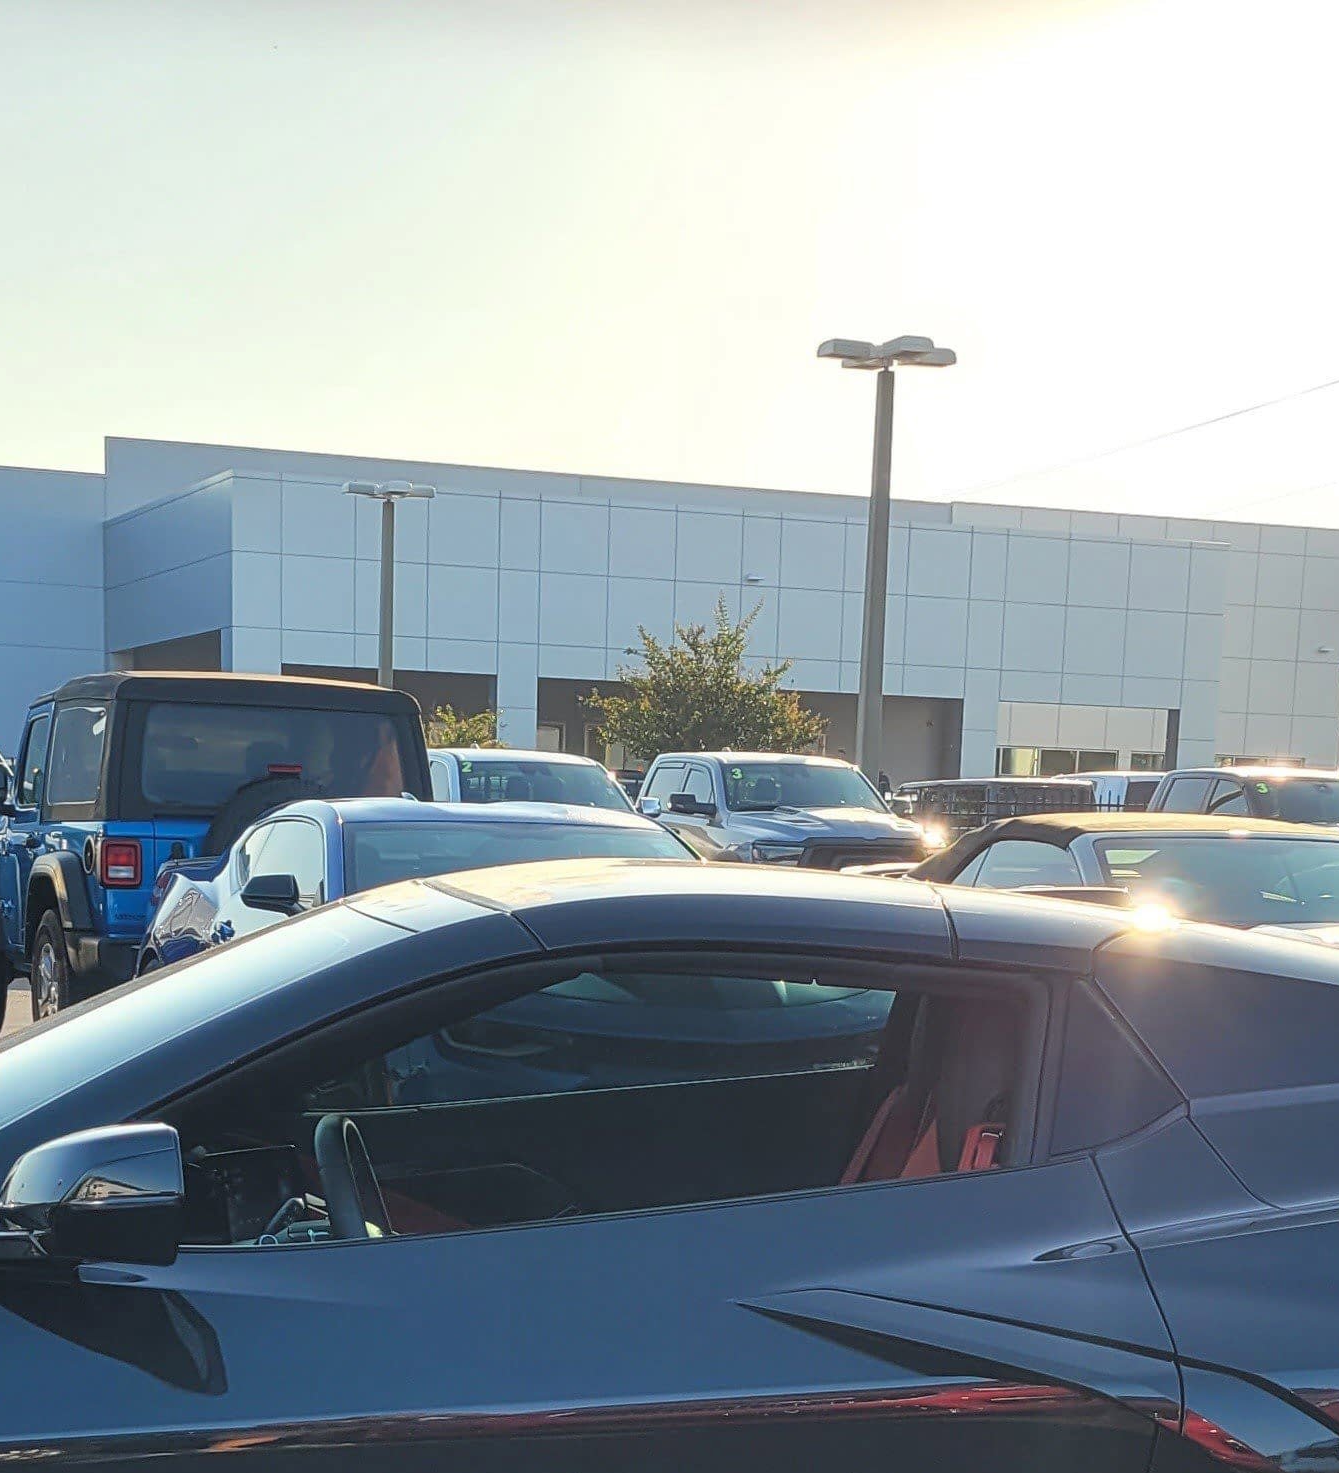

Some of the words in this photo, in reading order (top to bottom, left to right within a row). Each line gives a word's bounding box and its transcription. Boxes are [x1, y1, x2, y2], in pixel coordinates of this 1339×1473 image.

[462, 761, 472, 773] 2
[731, 768, 743, 779] 3
[1256, 782, 1268, 794] 3
